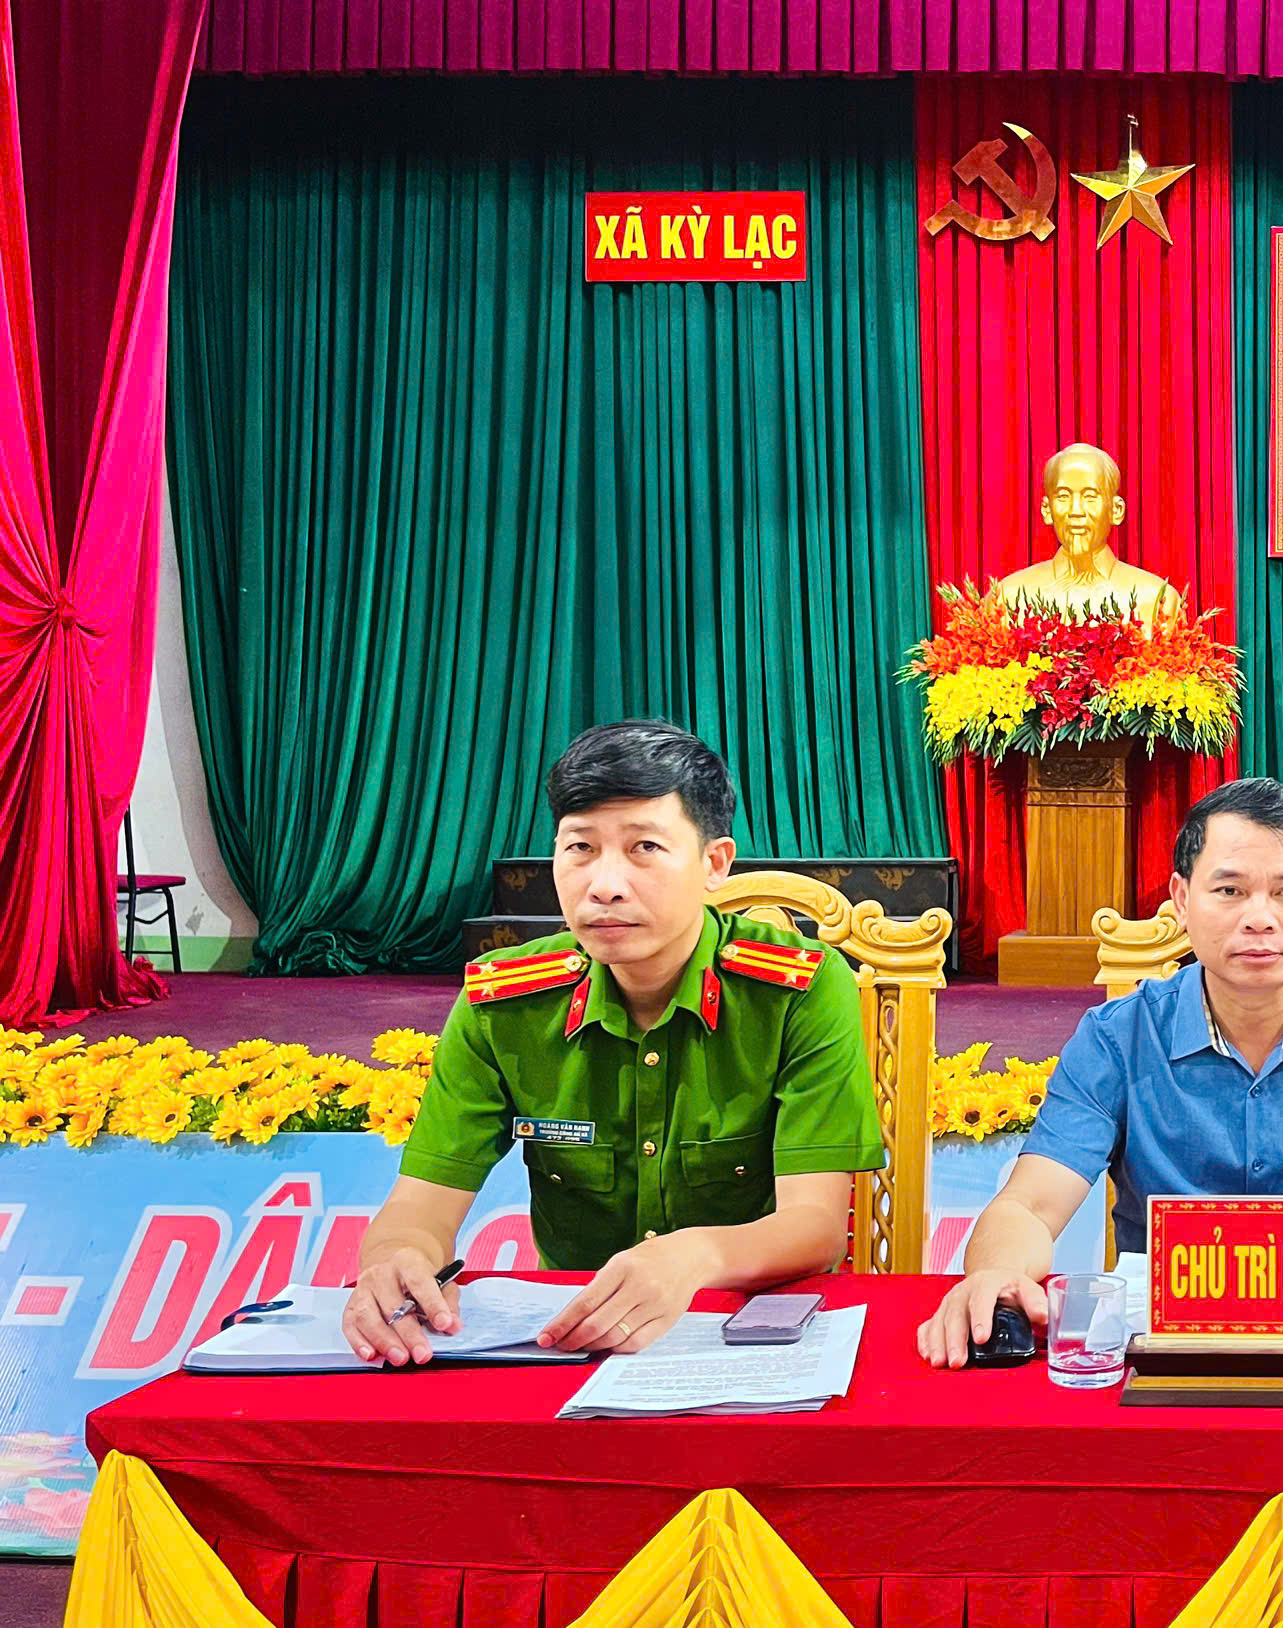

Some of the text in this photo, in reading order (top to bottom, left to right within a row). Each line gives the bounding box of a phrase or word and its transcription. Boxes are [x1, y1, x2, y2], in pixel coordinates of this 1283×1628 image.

[595, 206, 796, 269] XÃ KỲ LẠC
[1171, 1227, 1226, 1298] CHỦ
[1234, 1234, 1276, 1298] TRÌ
